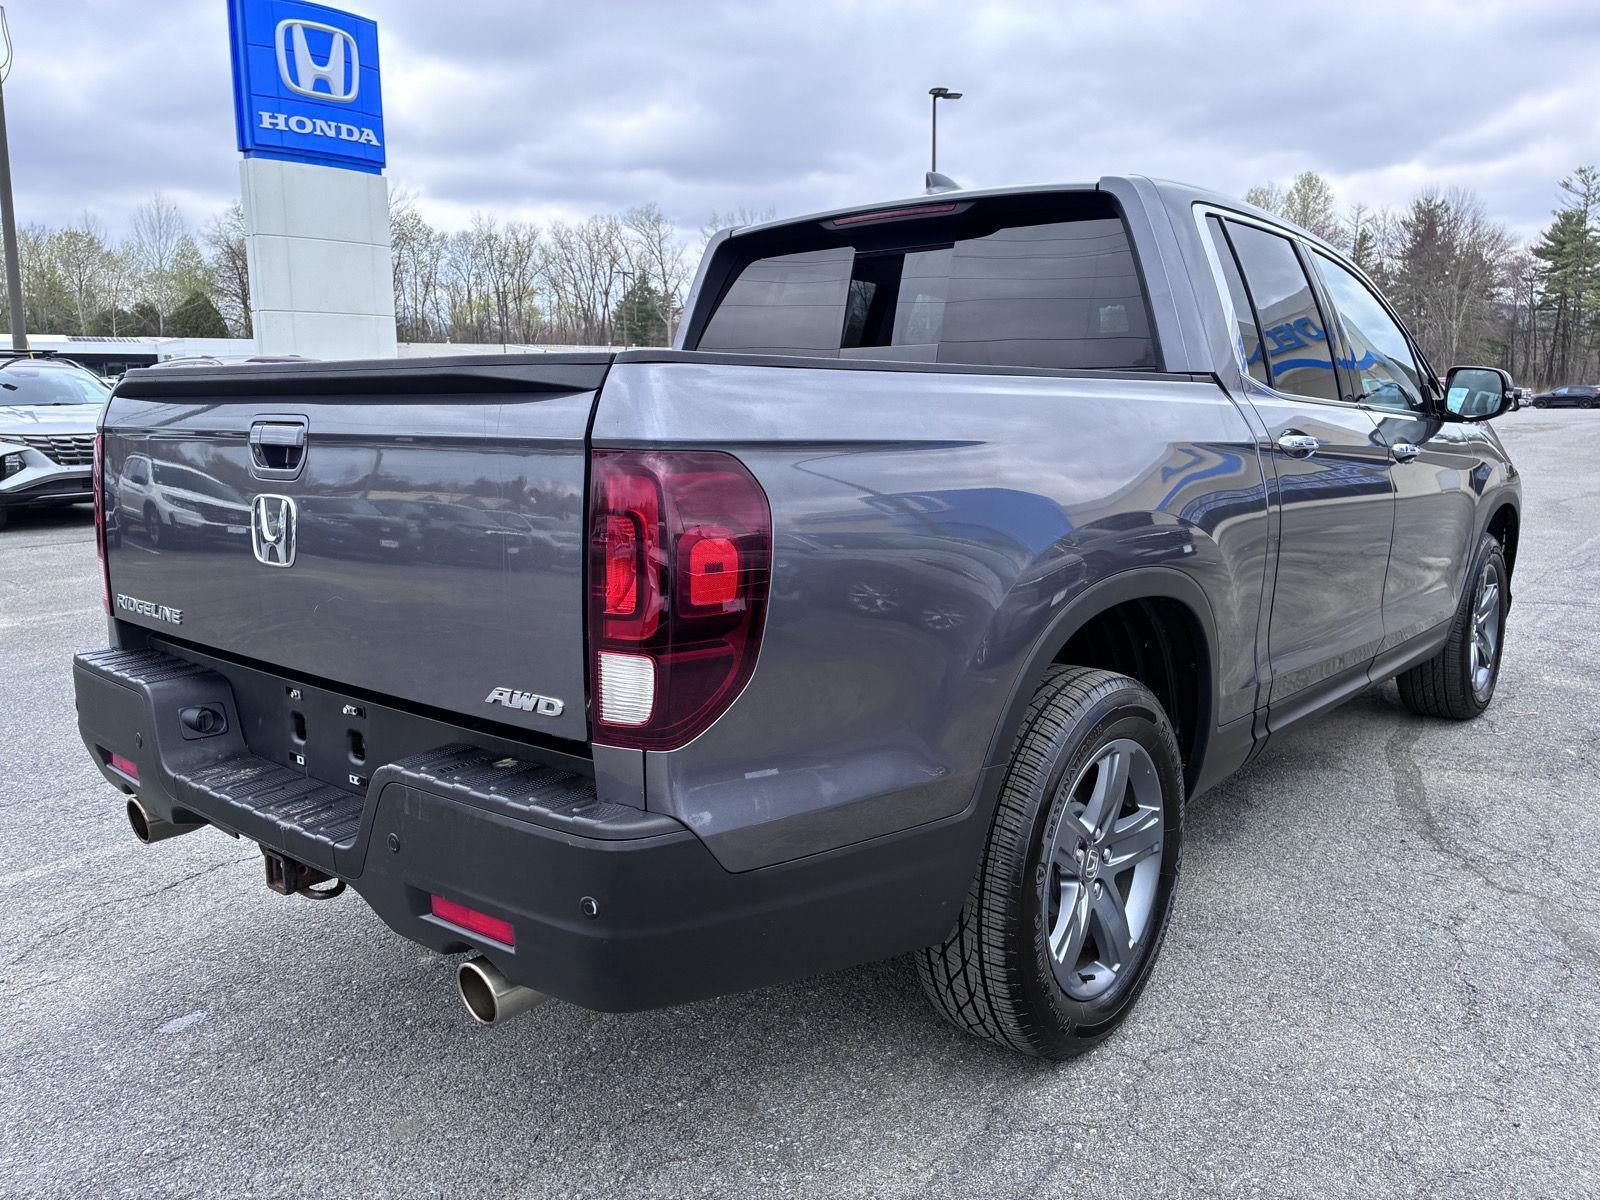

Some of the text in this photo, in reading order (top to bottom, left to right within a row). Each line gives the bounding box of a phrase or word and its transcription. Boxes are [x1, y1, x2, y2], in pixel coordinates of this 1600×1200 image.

[258, 111, 381, 146] HONDA
[116, 593, 183, 625] RIDGELINE
[485, 686, 565, 717] AWD
